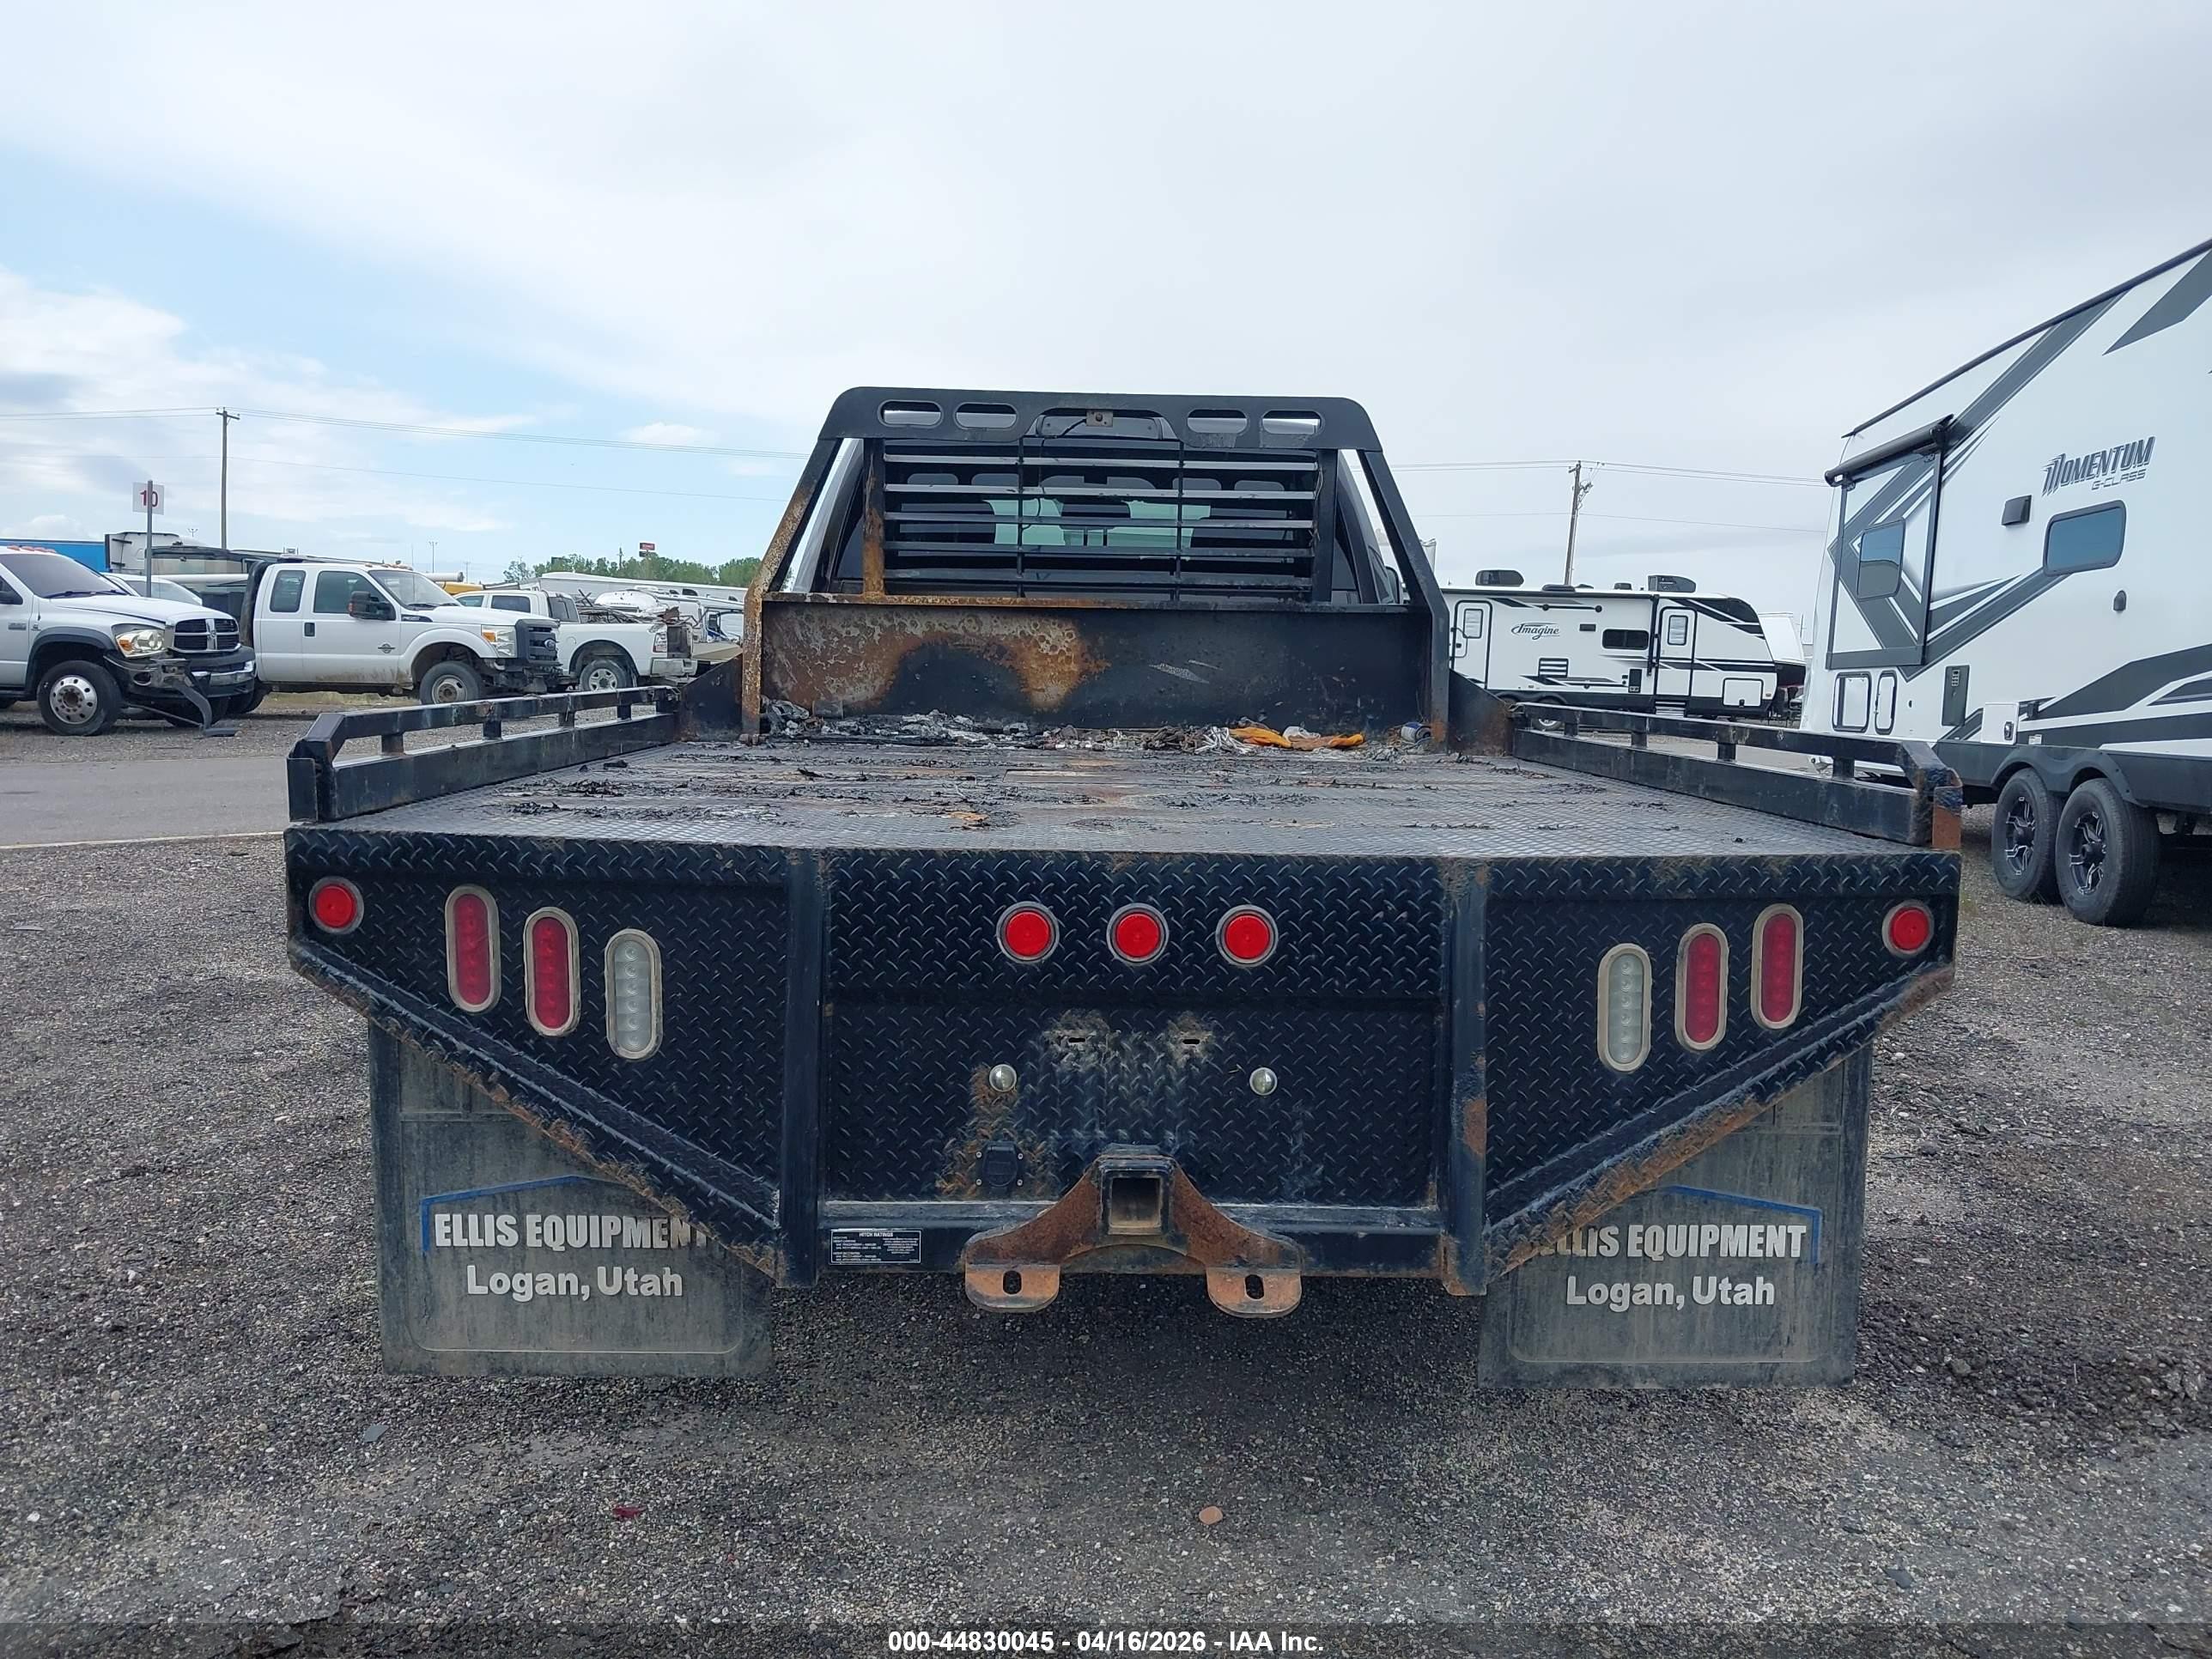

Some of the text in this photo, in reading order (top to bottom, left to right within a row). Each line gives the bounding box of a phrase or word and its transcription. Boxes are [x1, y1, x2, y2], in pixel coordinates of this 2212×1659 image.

[2042, 435, 2156, 497] MOMENTUM
[2091, 468, 2147, 490] G-CLASS
[139, 489, 159, 507] 10
[1511, 623, 1560, 641] Imagine
[434, 1213, 519, 1247] ELLIS
[1540, 1224, 1807, 1261] LLIS EQUIPMENT
[466, 1265, 683, 1302] Logan, Utah
[1566, 1275, 1775, 1312] Logan, Utah
